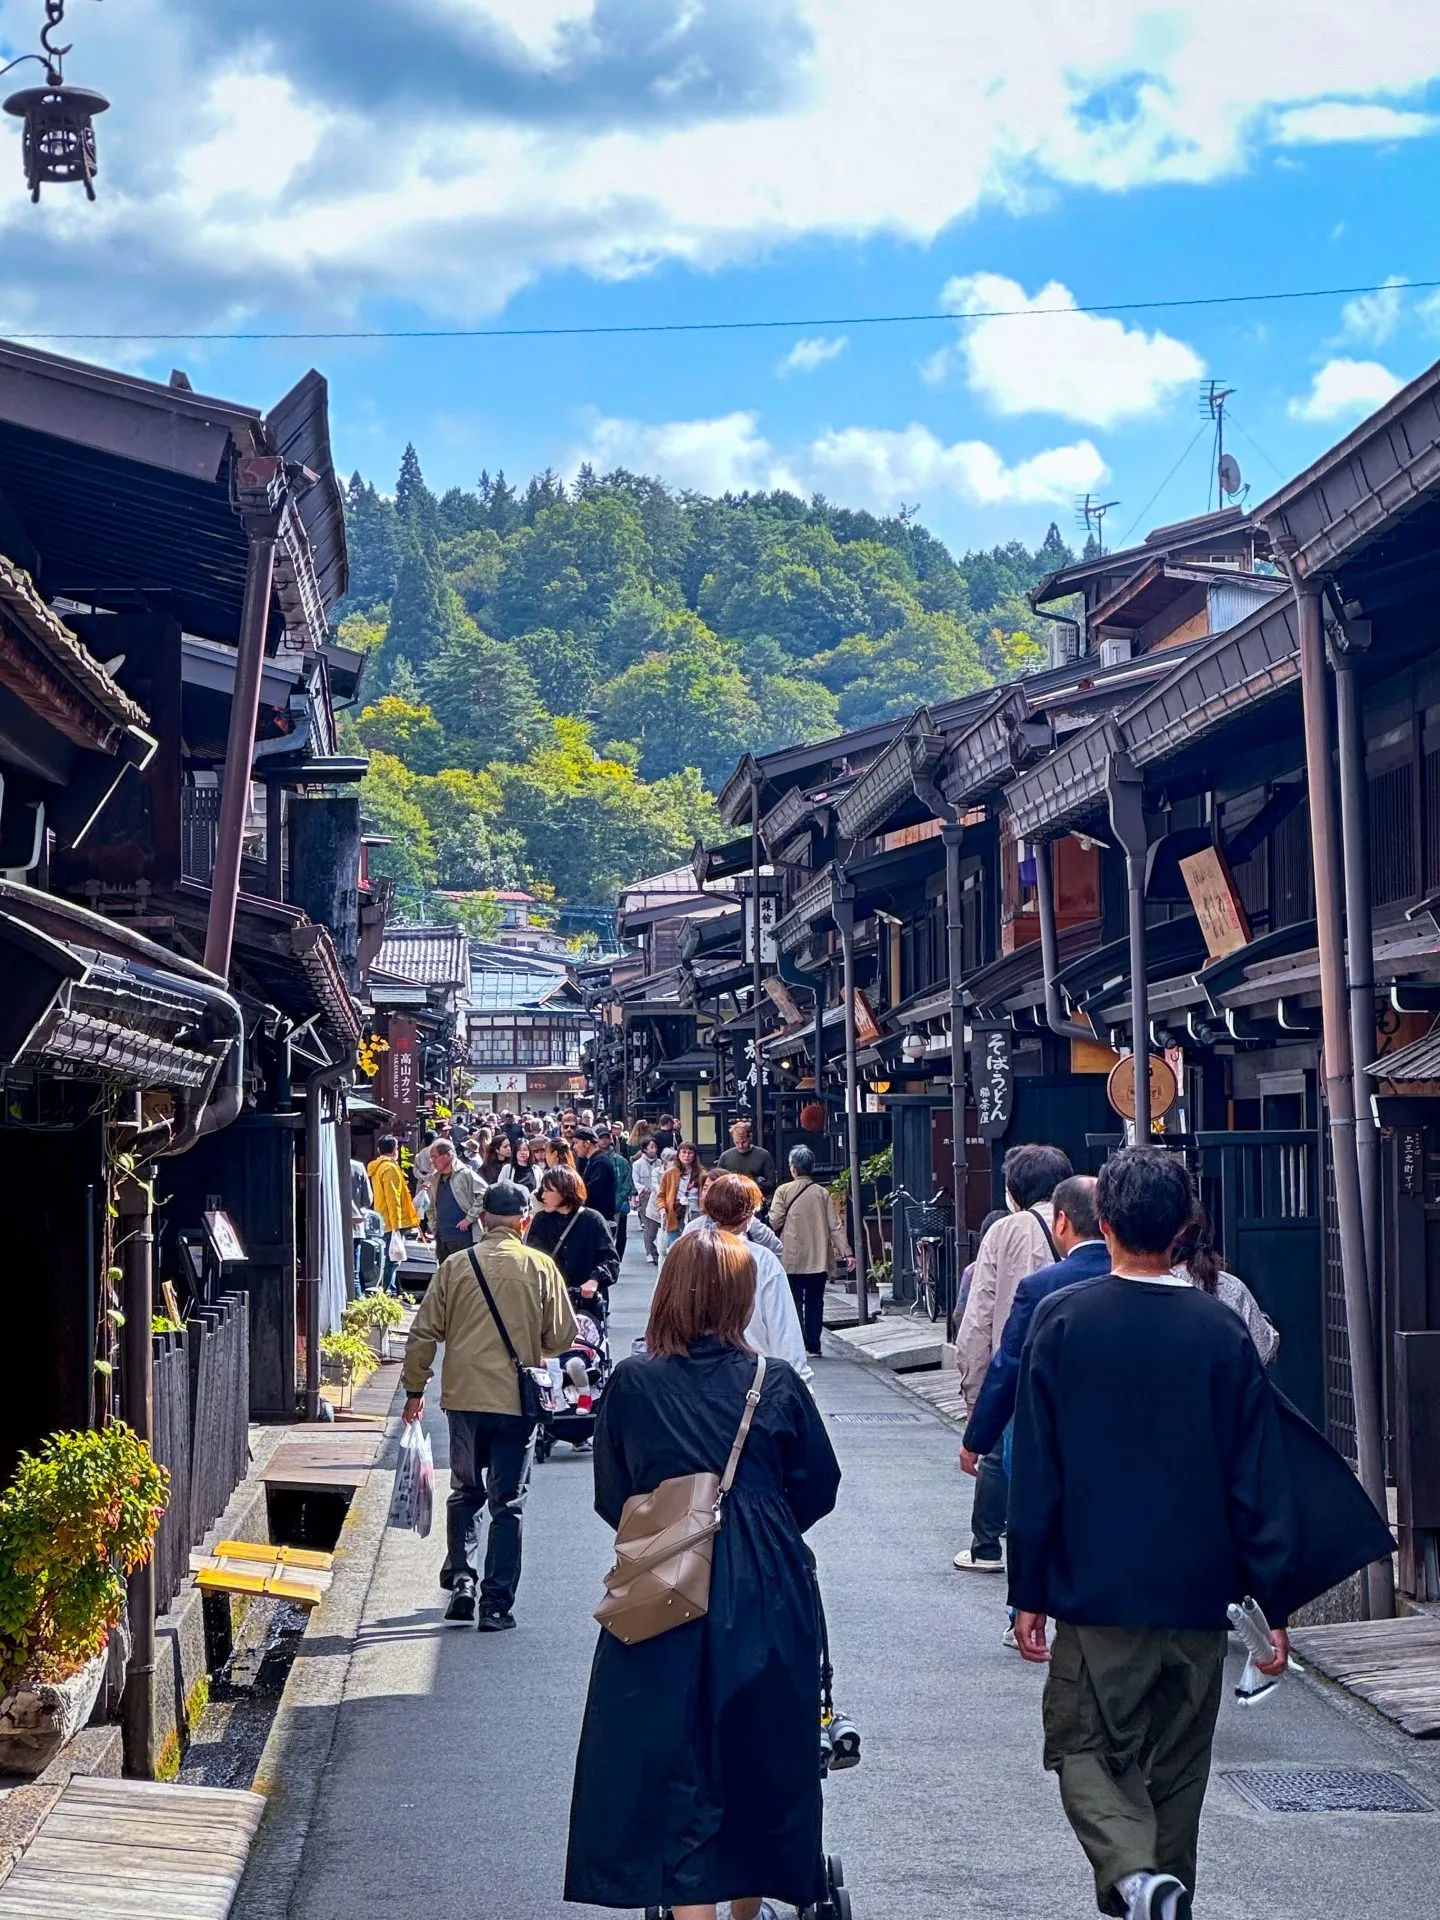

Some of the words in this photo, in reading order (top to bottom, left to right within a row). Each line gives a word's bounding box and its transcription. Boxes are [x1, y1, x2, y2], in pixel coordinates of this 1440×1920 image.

[400, 1052, 412, 1104] 高山カフェ
